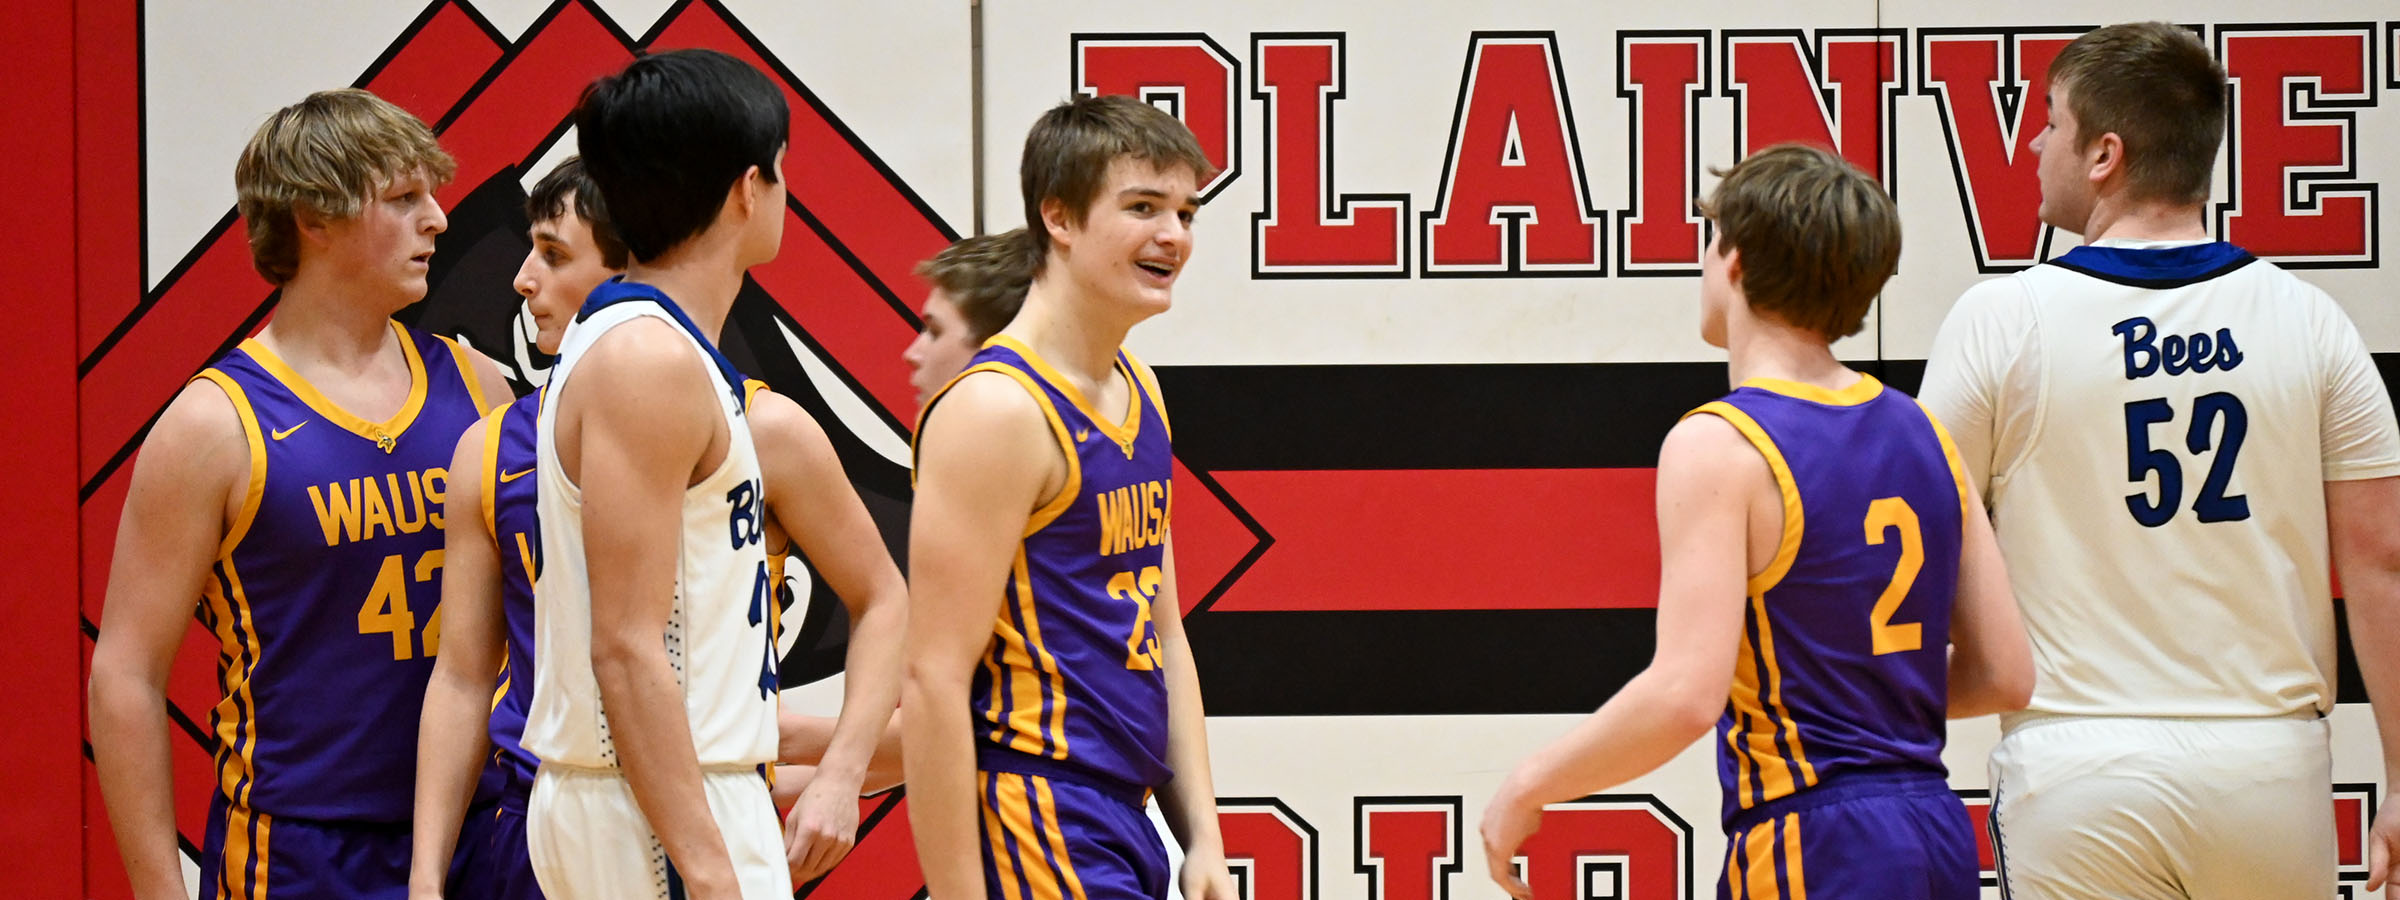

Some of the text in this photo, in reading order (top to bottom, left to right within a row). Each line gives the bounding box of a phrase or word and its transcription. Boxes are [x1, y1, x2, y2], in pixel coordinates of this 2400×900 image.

[1071, 21, 2400, 280] PLAINVE
[2112, 316, 2244, 380] Bees
[306, 467, 449, 547] WAUS
[2124, 391, 2251, 528] 52
[357, 548, 445, 661] 42
[1863, 496, 1925, 656] 2
